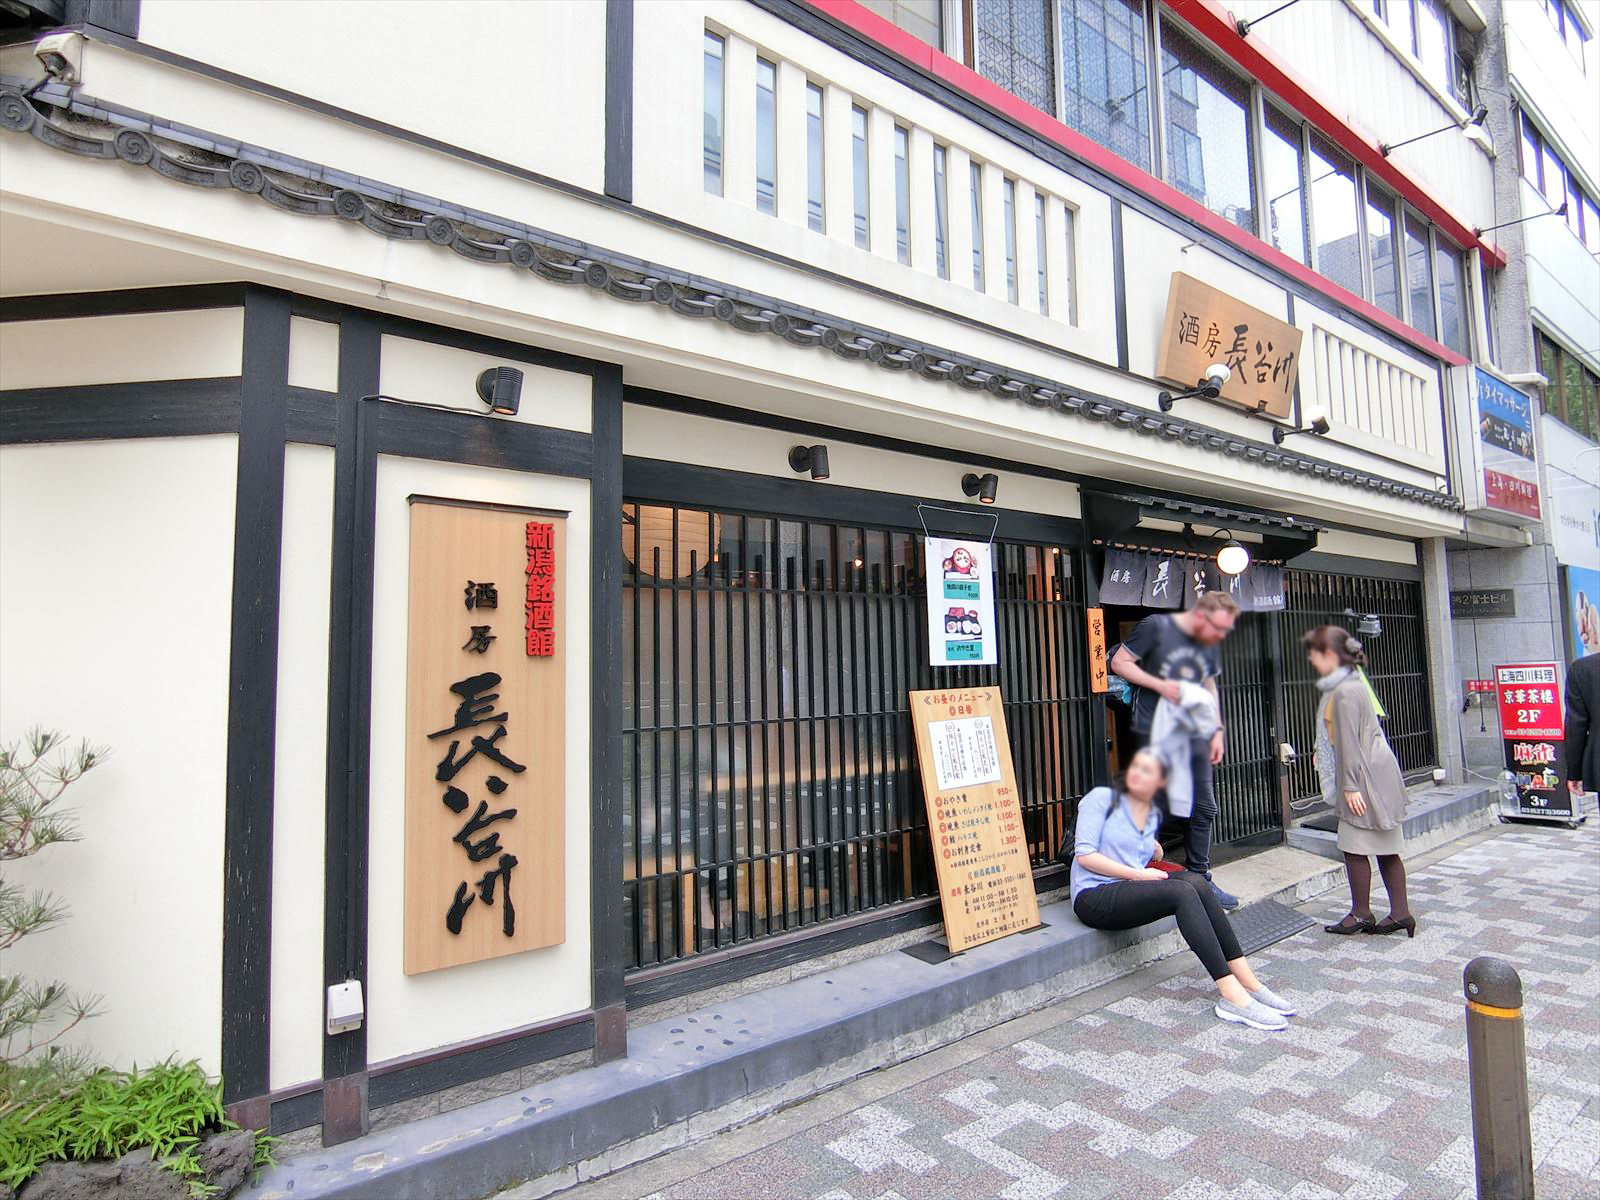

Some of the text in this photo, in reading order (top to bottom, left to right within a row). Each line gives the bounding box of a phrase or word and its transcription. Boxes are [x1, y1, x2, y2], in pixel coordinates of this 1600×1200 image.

[1179, 311, 1294, 394] 酒房 長谷川
[1110, 569, 1132, 583] 酒房
[525, 521, 555, 657] 新潟銘酒館
[1092, 618, 1105, 685] 営業中
[1500, 669, 1554, 683] 上海四川料理
[1503, 689, 1554, 705] 京華茶楼
[1517, 709, 1541, 723] 2F
[427, 580, 527, 937] 酒房 長谷川
[1513, 742, 1557, 762] 麻雀
[1517, 772, 1559, 788] MAP
[1530, 795, 1548, 806] 3F
[945, 808, 957, 819] 焼魚
[947, 820, 959, 831] 焼魚
[951, 842, 982, 857] お刺身定食
[963, 881, 983, 894] 長谷川
